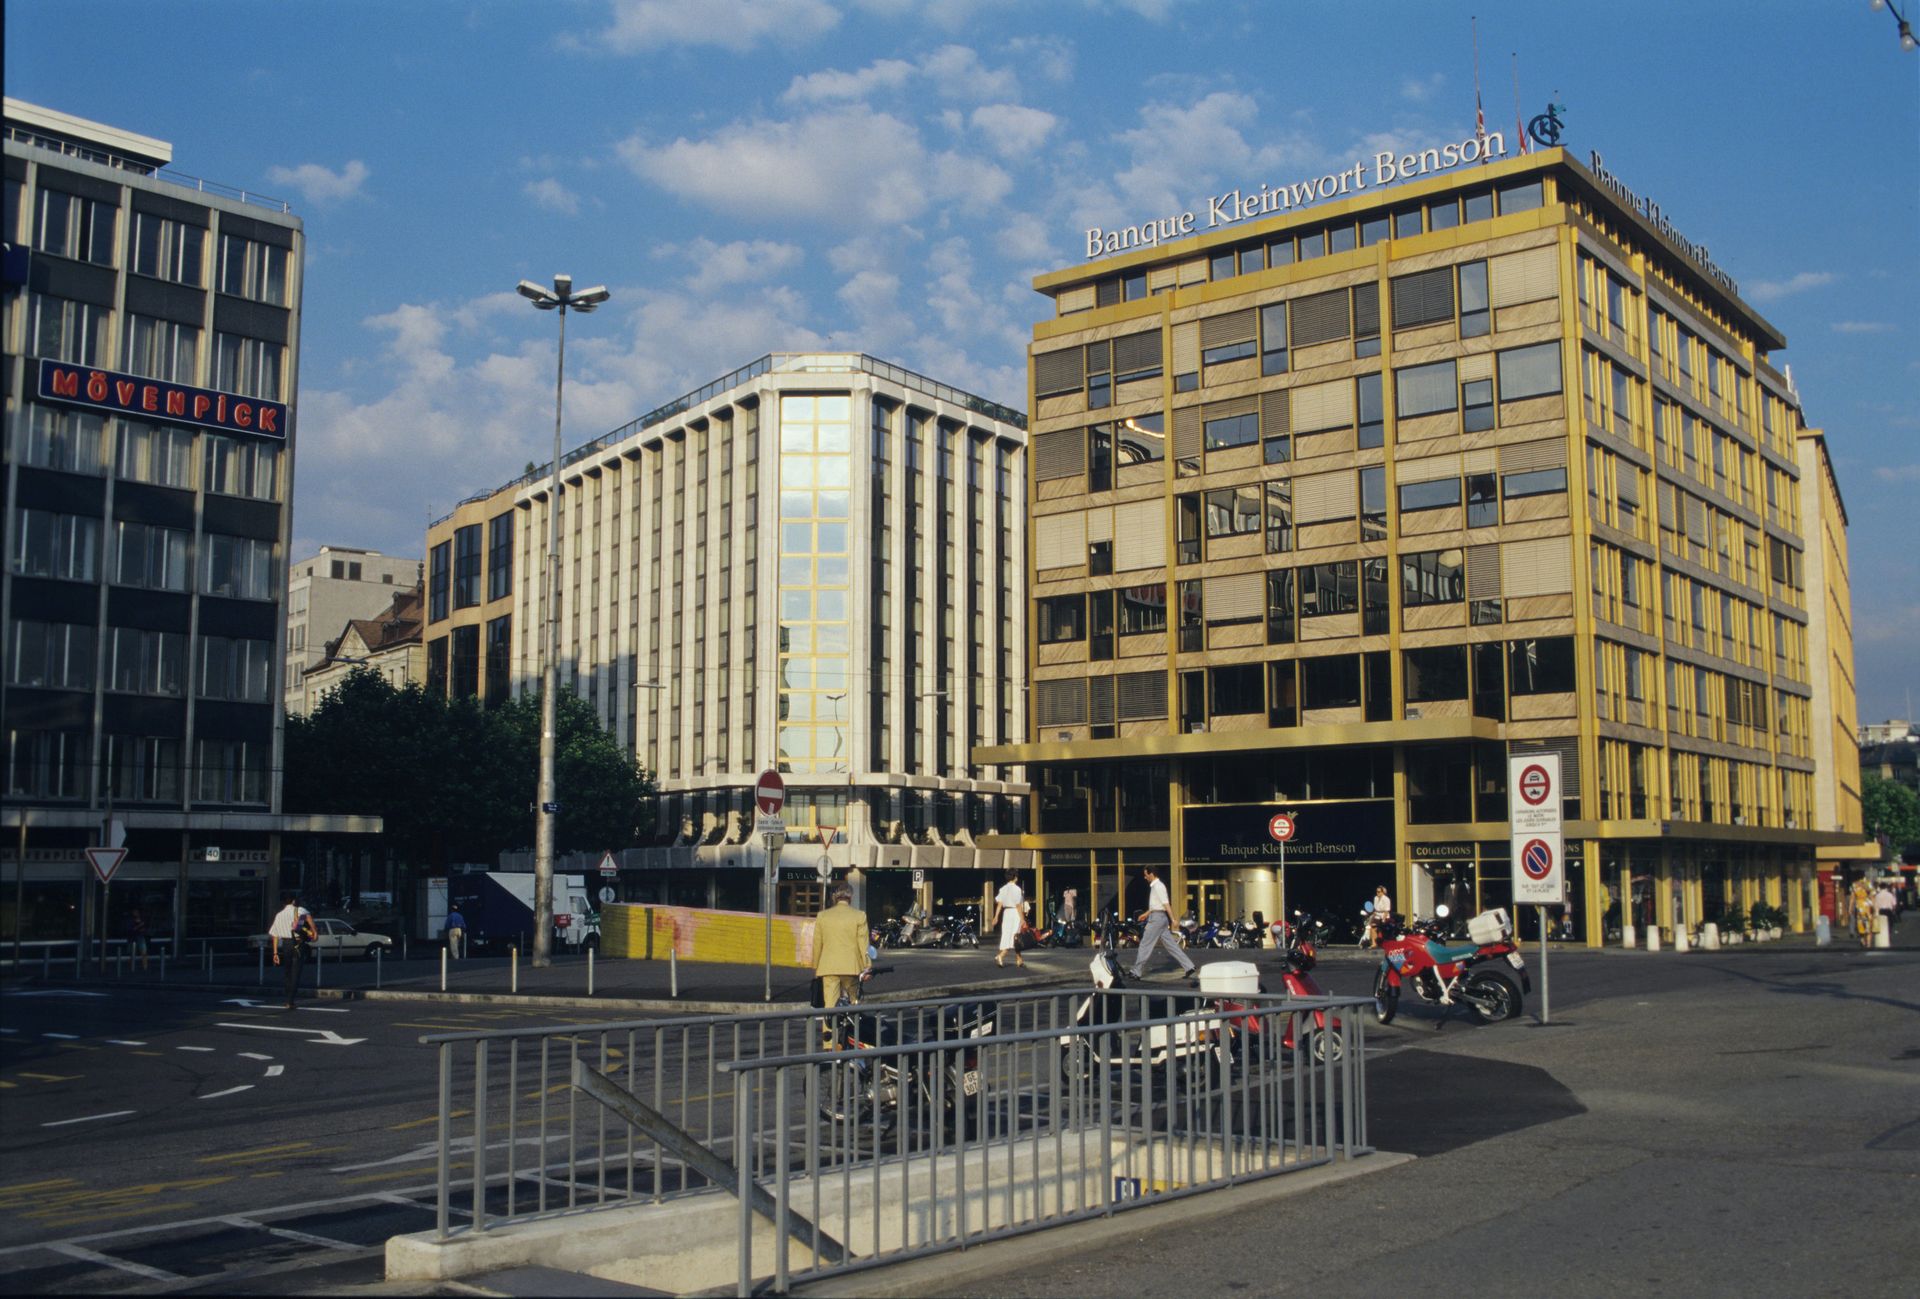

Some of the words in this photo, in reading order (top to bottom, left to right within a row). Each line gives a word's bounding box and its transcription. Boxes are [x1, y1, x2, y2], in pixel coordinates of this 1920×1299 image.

[1086, 211, 1196, 258] Banque
[1207, 161, 1367, 228] Kleinwort
[1374, 132, 1507, 185] Benson
[207, 849, 219, 858] 40
[1220, 844, 1259, 858] Banque
[1262, 843, 1313, 855] Klenwort
[1315, 842, 1356, 853] Benson
[1416, 846, 1471, 855] COLLECTIONS
[787, 872, 839, 880] BVLGI
[915, 871, 922, 881] P
